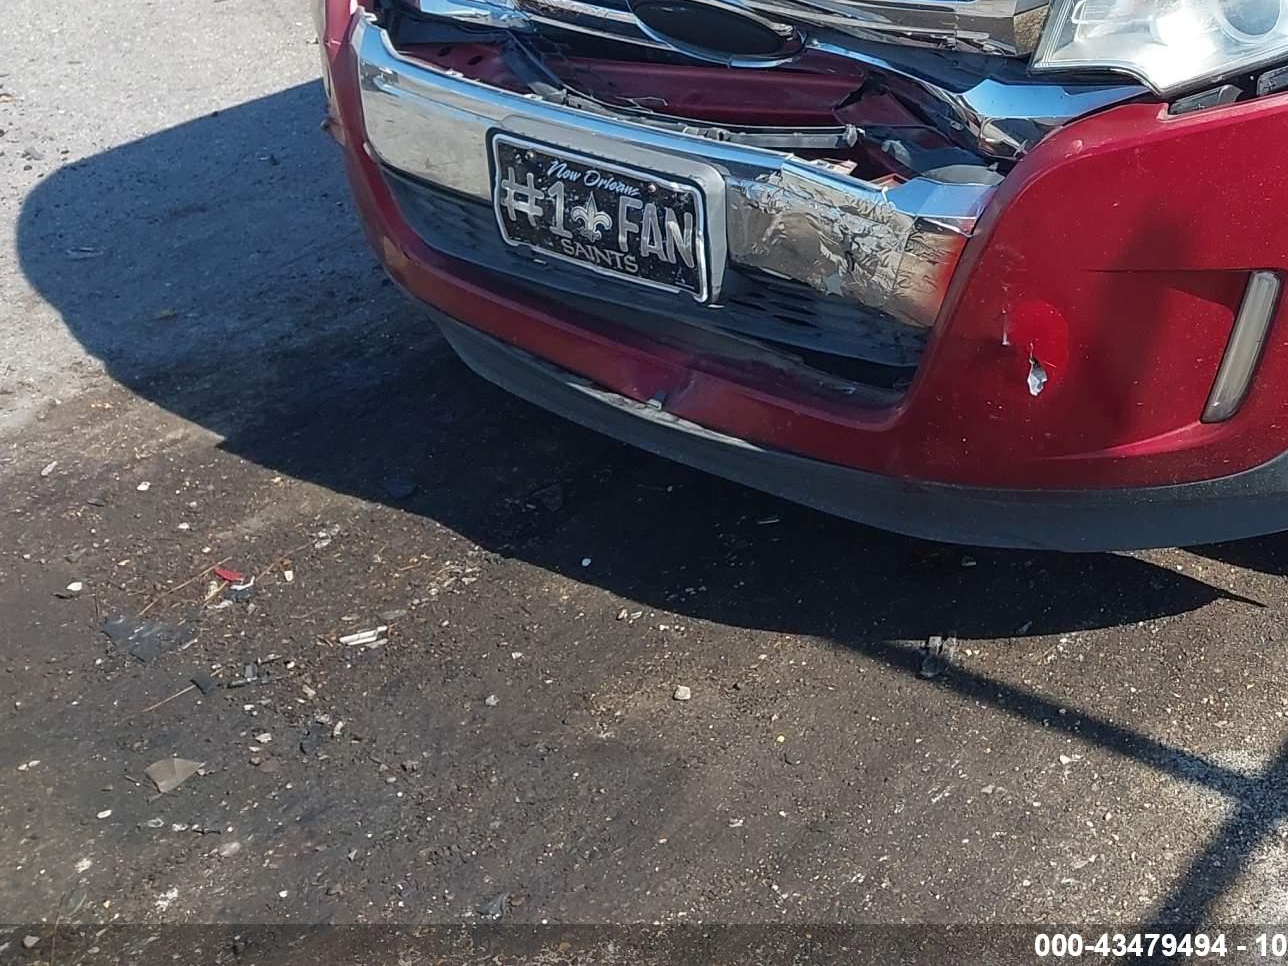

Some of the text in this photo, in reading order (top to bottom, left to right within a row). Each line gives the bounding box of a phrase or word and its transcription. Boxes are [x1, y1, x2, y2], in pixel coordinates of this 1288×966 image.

[548, 160, 641, 198] New Orleans
[501, 166, 695, 268] #1 FAN
[560, 237, 639, 274] SAINTS
